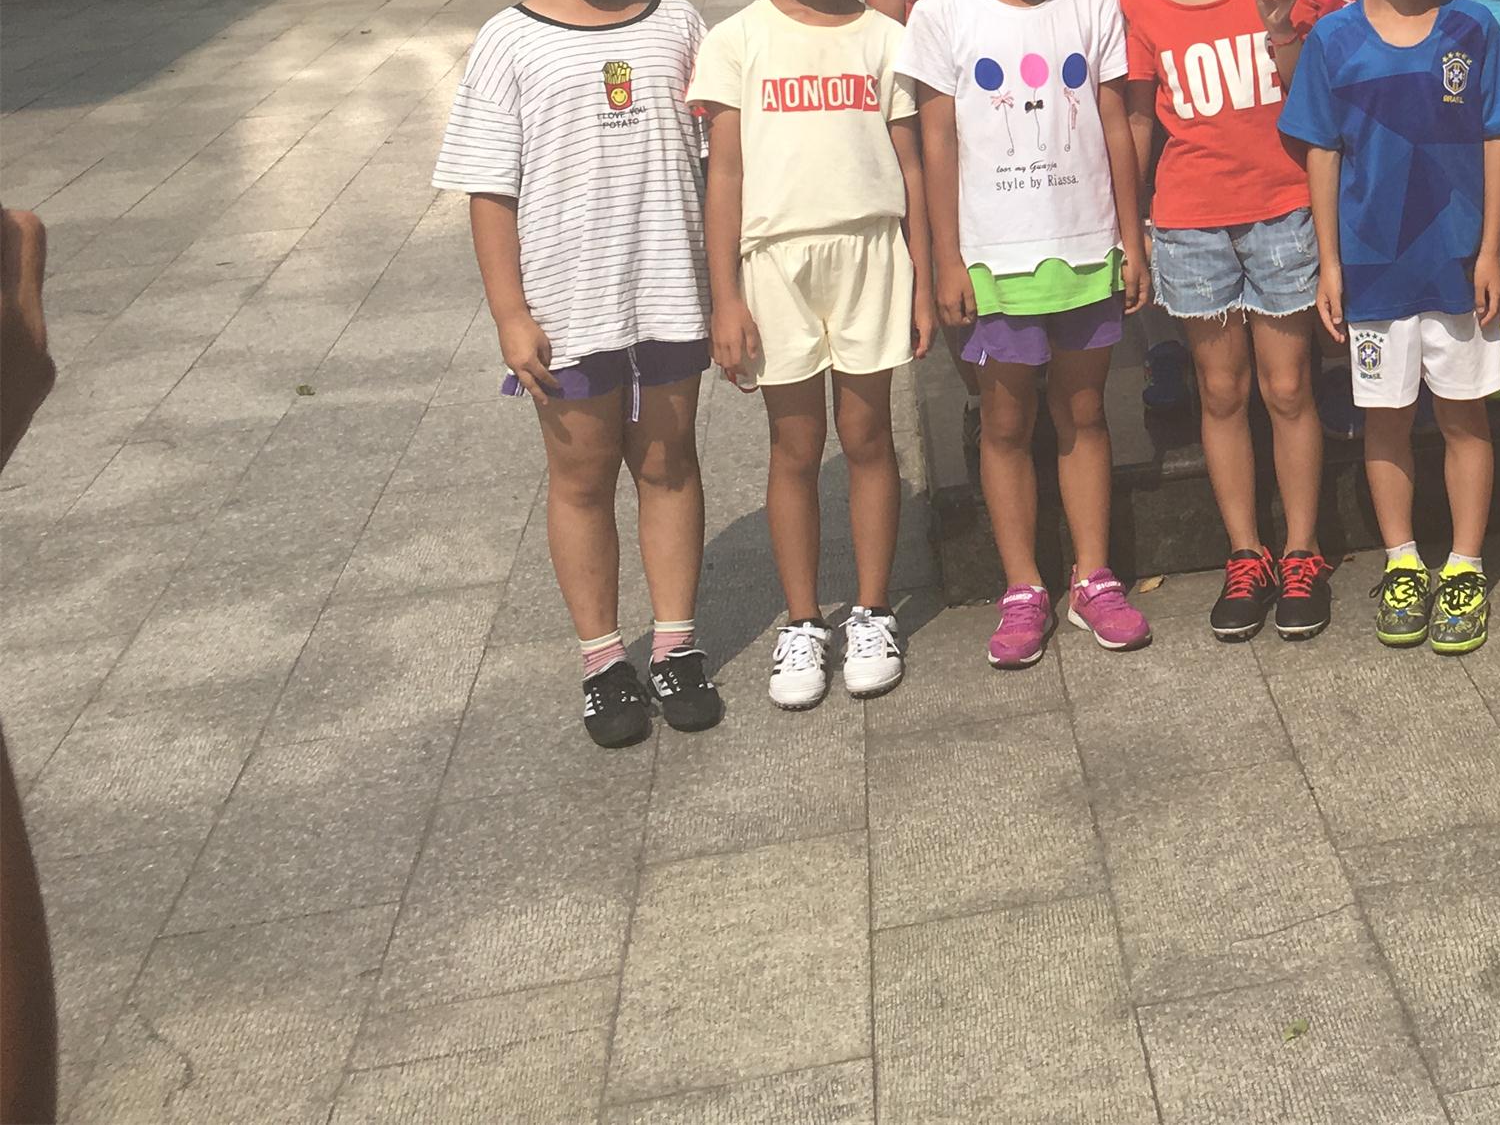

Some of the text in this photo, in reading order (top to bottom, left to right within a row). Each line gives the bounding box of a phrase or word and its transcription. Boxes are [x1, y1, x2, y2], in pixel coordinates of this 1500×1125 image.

[1160, 30, 1282, 119] LOVE
[995, 177, 1025, 191] style
[1030, 176, 1042, 189] by
